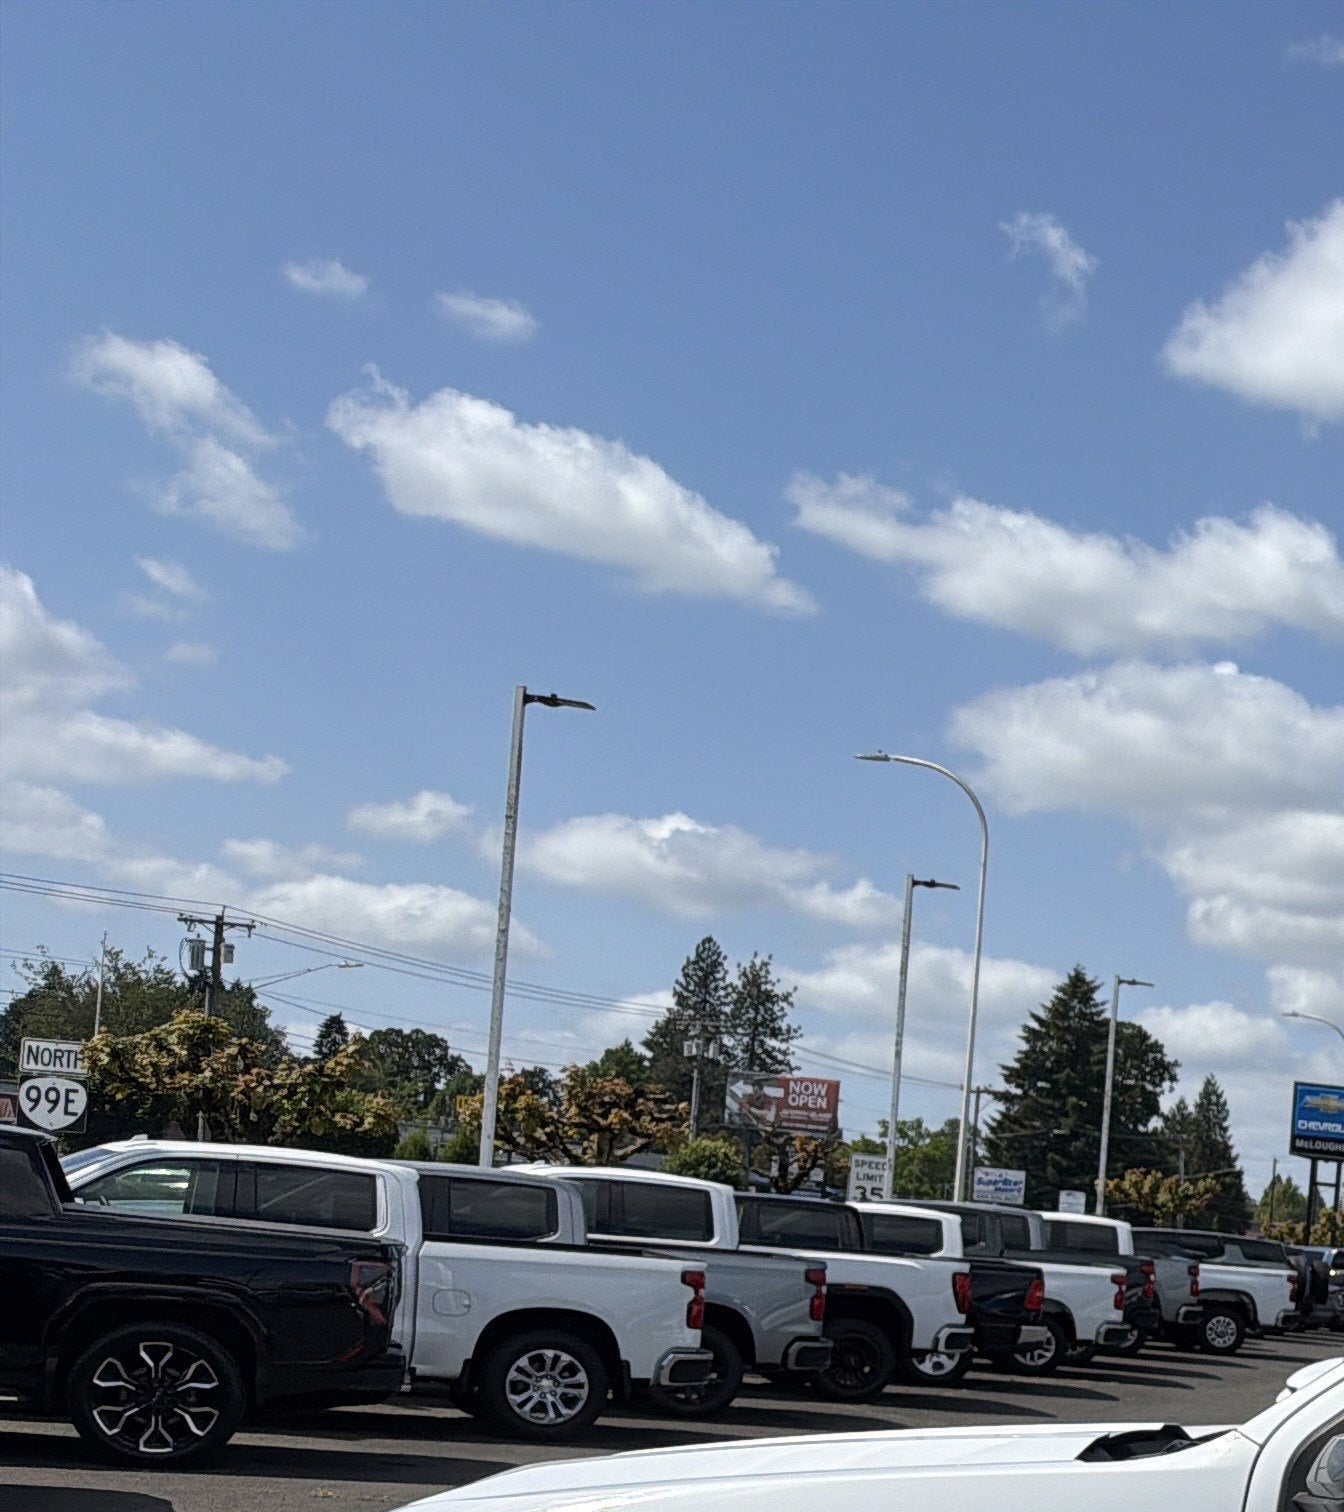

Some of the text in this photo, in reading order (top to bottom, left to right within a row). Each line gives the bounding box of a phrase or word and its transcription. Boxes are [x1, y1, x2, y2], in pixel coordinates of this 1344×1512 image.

[26, 1044, 85, 1070] NORTH
[788, 1081, 828, 1097] NOW
[25, 1085, 79, 1117] 99E
[787, 1094, 828, 1109] OPEN
[855, 1172, 884, 1184] LIMIT
[855, 1186, 884, 1202] 35
